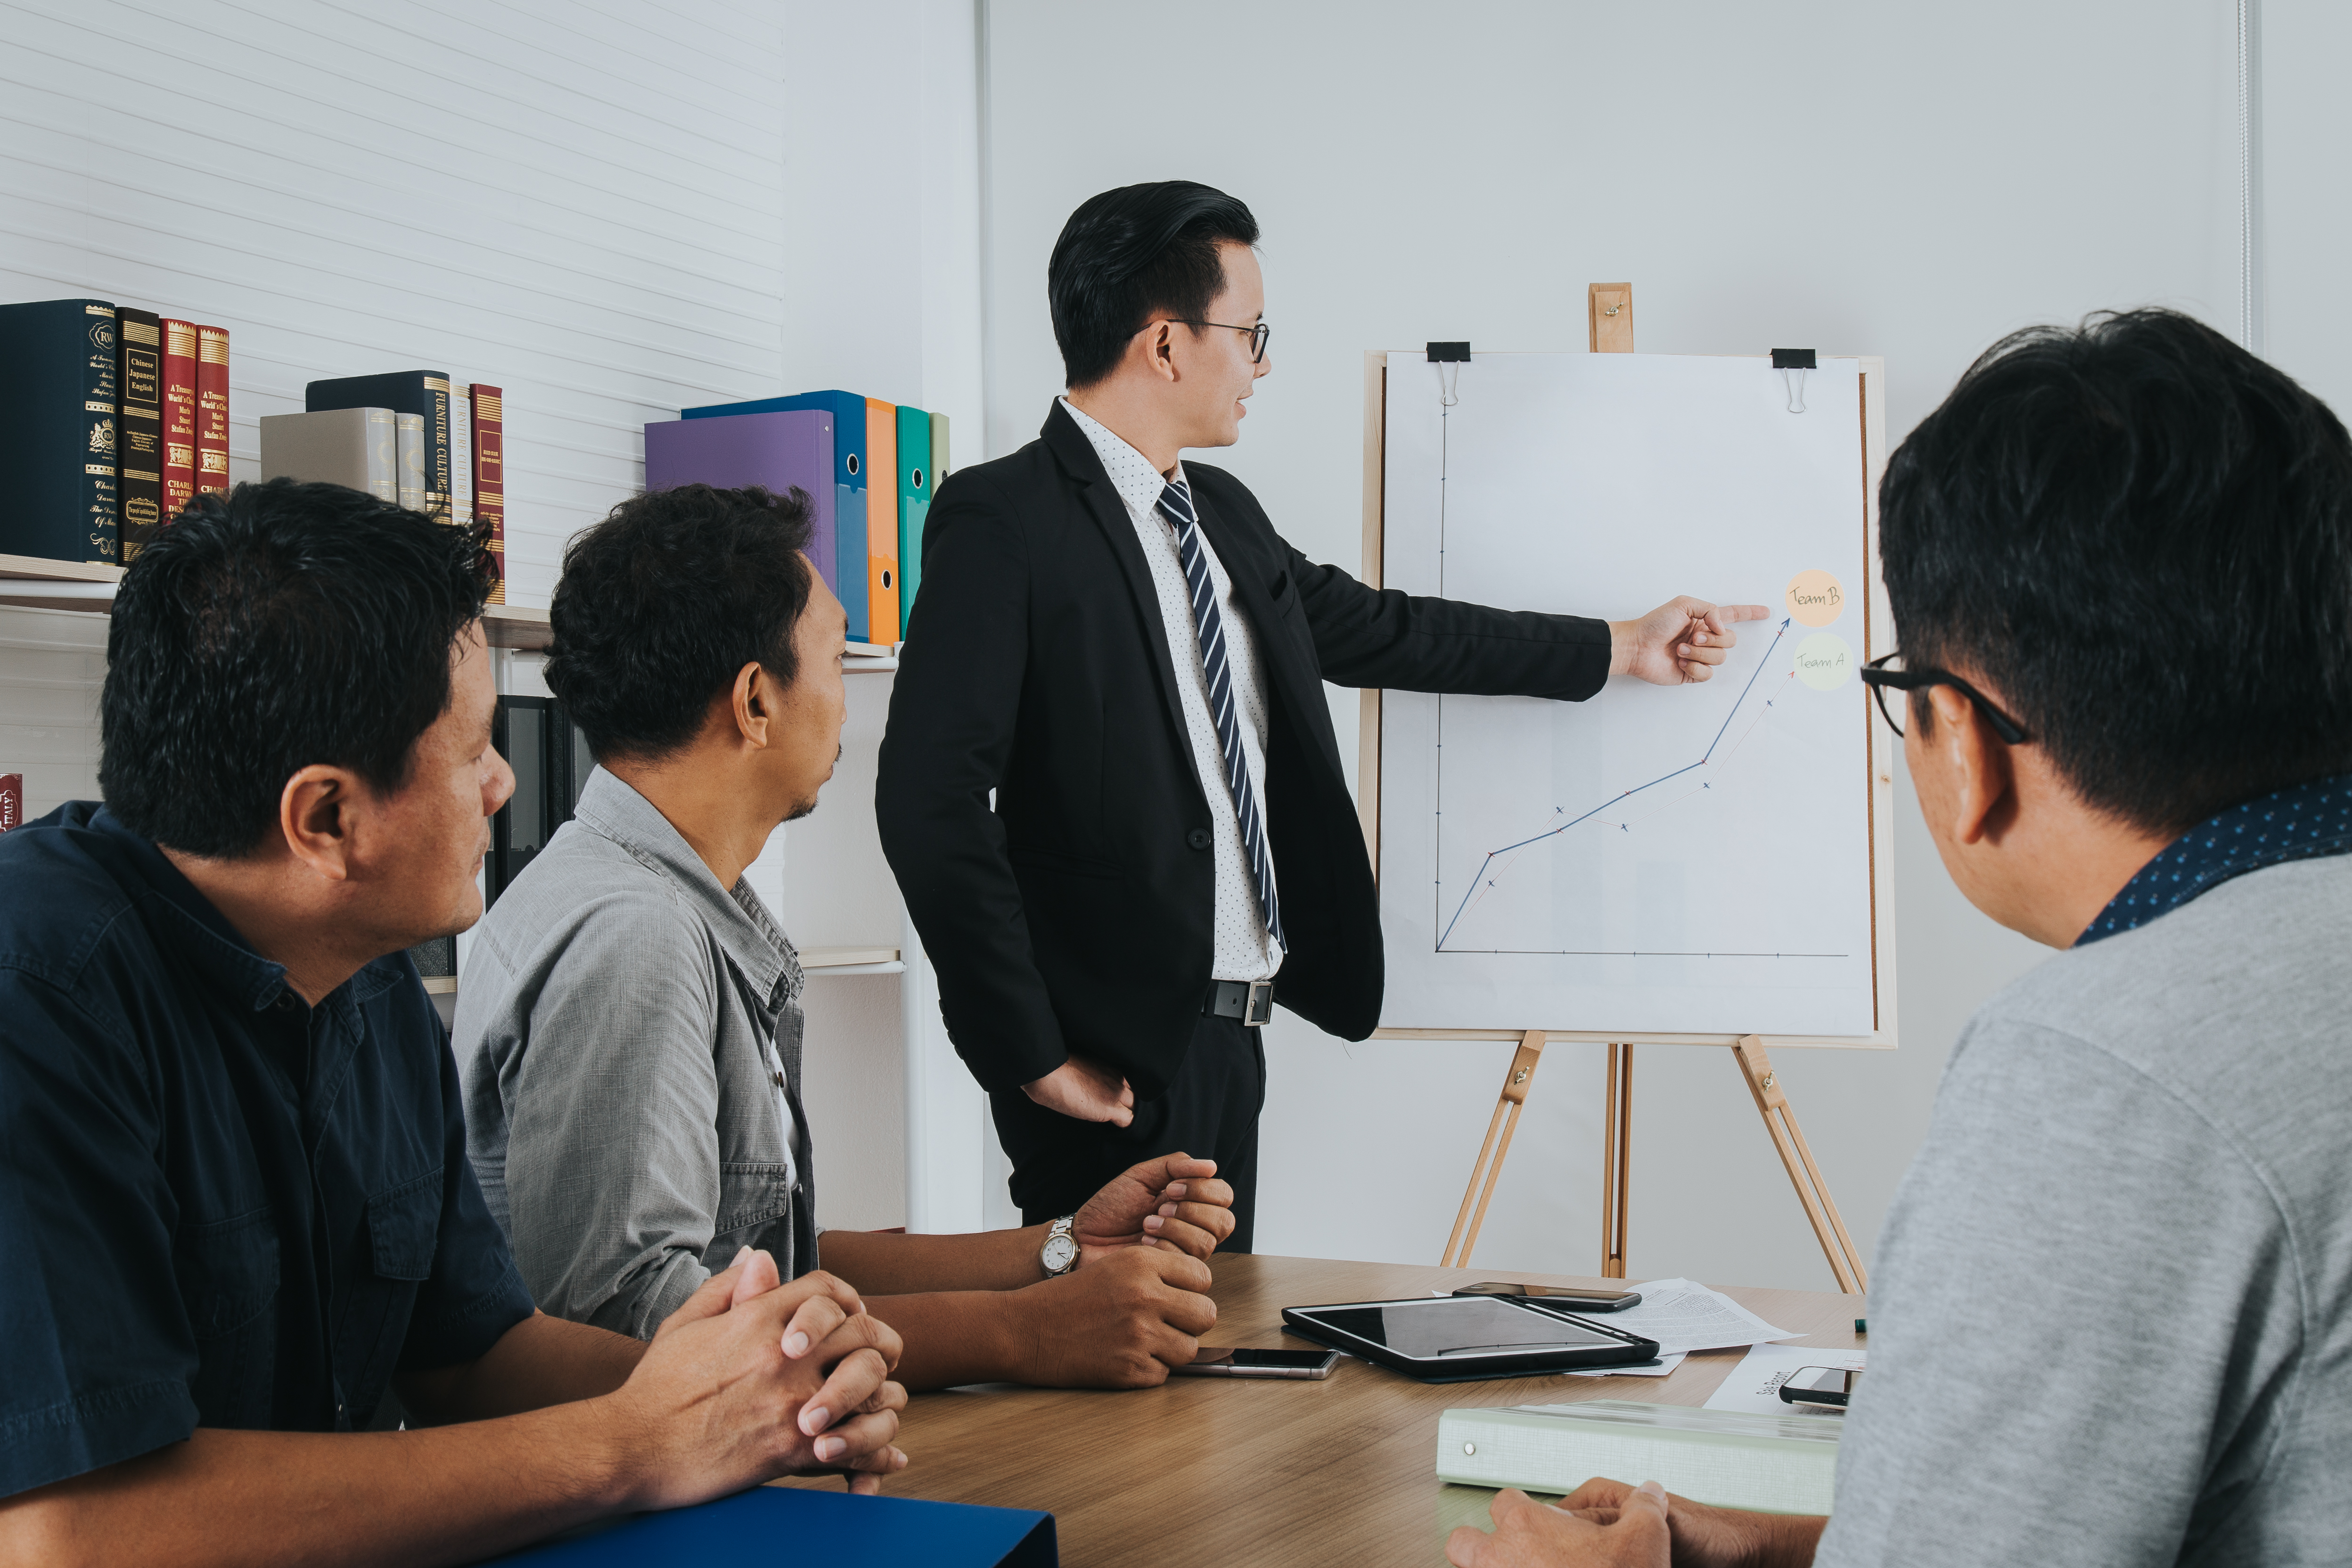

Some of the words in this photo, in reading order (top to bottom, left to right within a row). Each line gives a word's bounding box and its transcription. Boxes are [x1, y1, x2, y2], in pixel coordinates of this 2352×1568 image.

[100, 331, 114, 343] RW
[131, 358, 154, 369] Chinese
[129, 369, 156, 380] Japanese
[131, 381, 153, 392] English
[170, 384, 175, 392] A
[175, 384, 192, 397] Treasury
[203, 391, 208, 399] A
[208, 391, 225, 403] Treasury
[435, 392, 447, 445] FURNITURE
[457, 399, 467, 451] FURNITURE
[436, 447, 448, 491] CULTURE
[457, 454, 467, 497] CULTURE
[1789, 586, 1826, 606] Team
[1827, 586, 1840, 606] B
[1796, 653, 1831, 669] Team
[1836, 652, 1844, 666] A
[4, 796, 13, 824] ITALY
[1763, 1370, 1791, 1386] Report
[1755, 1386, 1779, 1395] Sale
